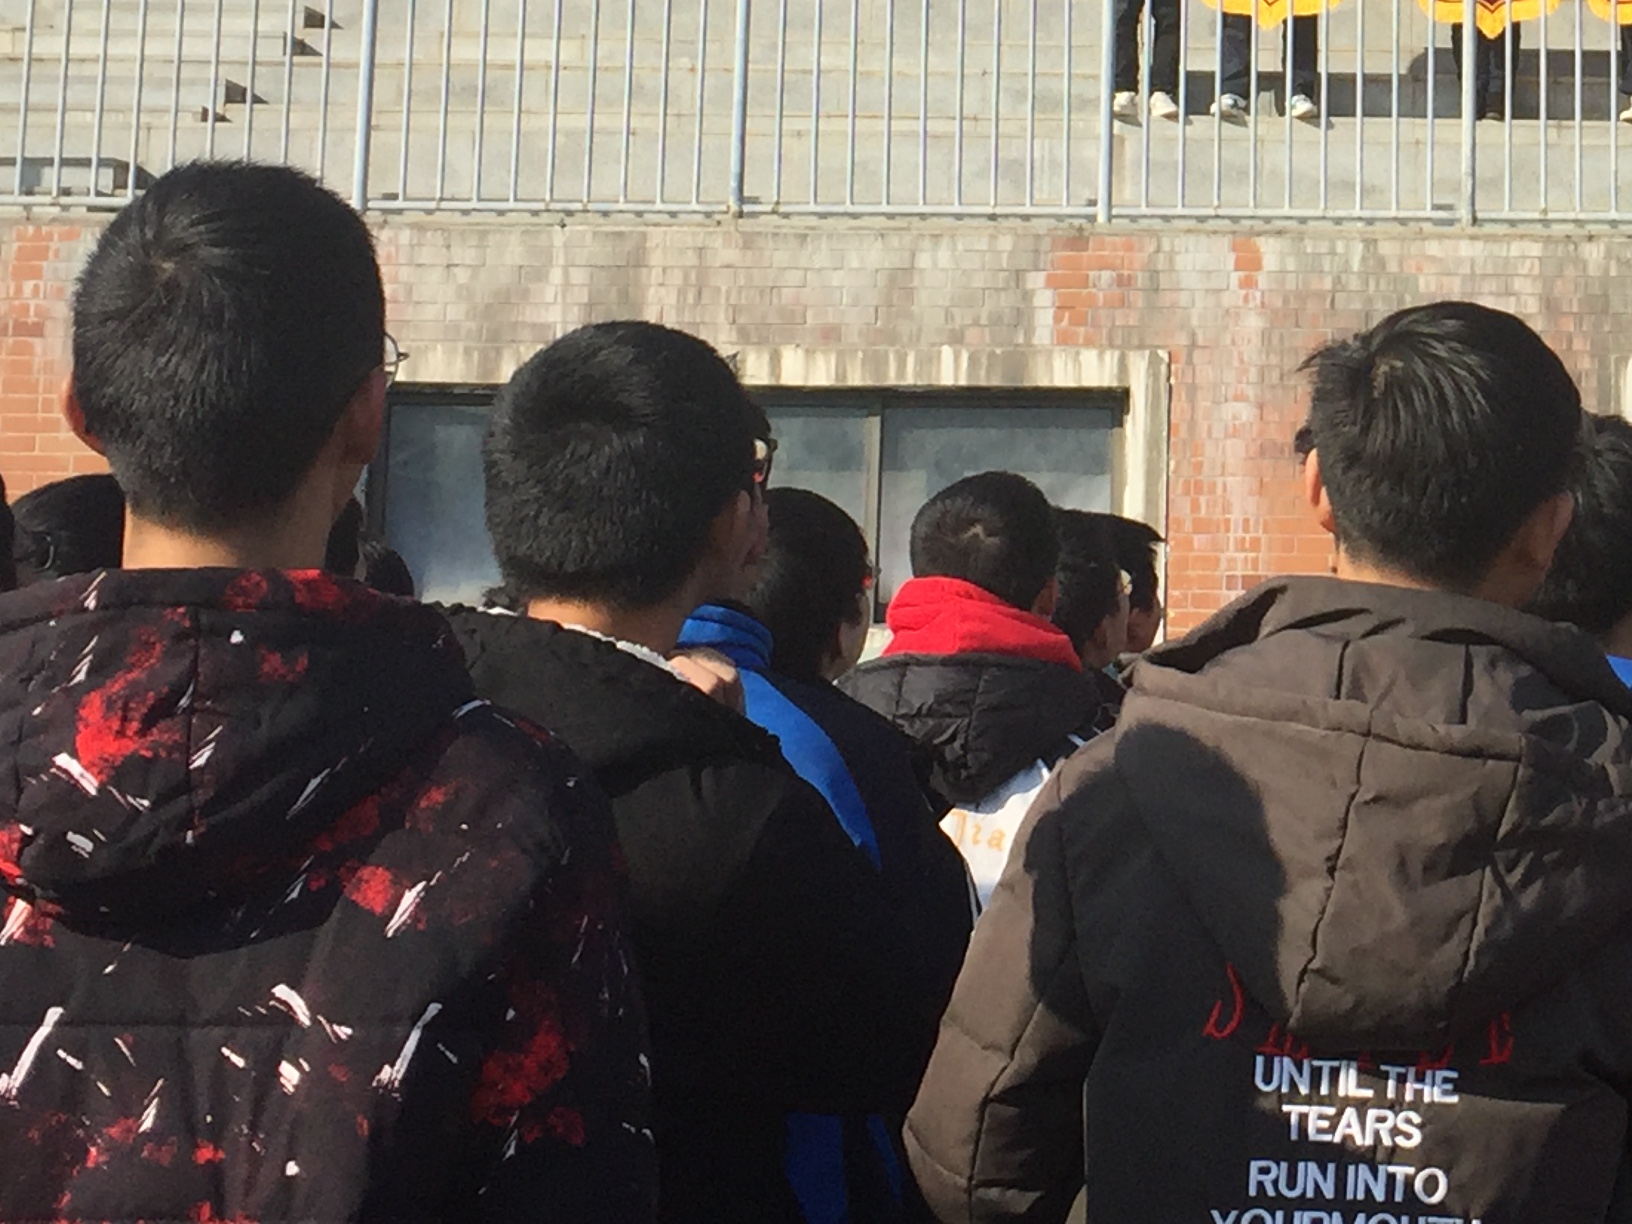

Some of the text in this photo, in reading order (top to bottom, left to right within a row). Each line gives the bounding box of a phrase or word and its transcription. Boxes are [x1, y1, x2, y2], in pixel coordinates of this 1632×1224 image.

[1253, 1054, 1460, 1104] UNTIL THE
[1282, 1103, 1423, 1149] TEARS
[1247, 1159, 1449, 1205] RUN INTO
